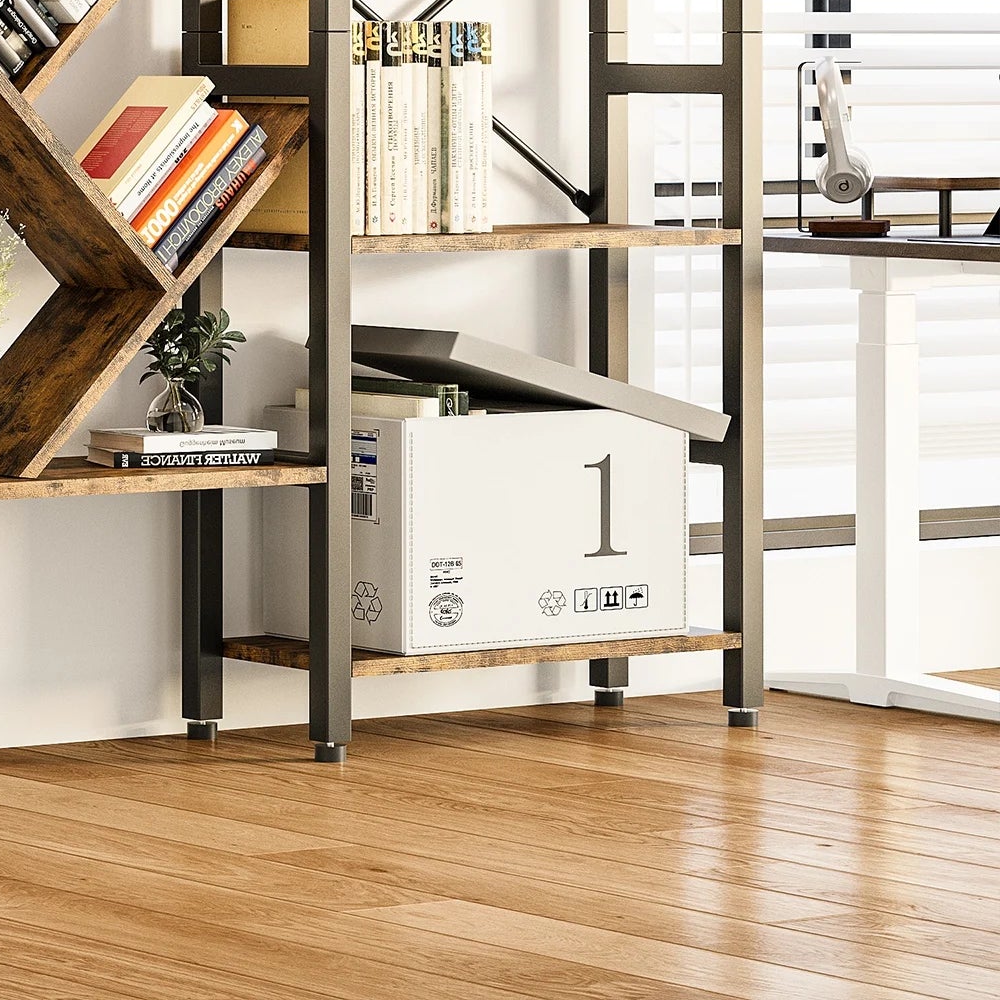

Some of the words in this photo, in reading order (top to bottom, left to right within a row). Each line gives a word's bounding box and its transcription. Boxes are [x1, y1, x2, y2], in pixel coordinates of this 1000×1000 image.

[187, 121, 200, 135] The
[158, 131, 189, 171] Impressionists
[227, 131, 262, 177] ALEXEY
[137, 178, 151, 196] Home
[164, 178, 226, 254] BRODOVITCH
[584, 453, 628, 558] 1
